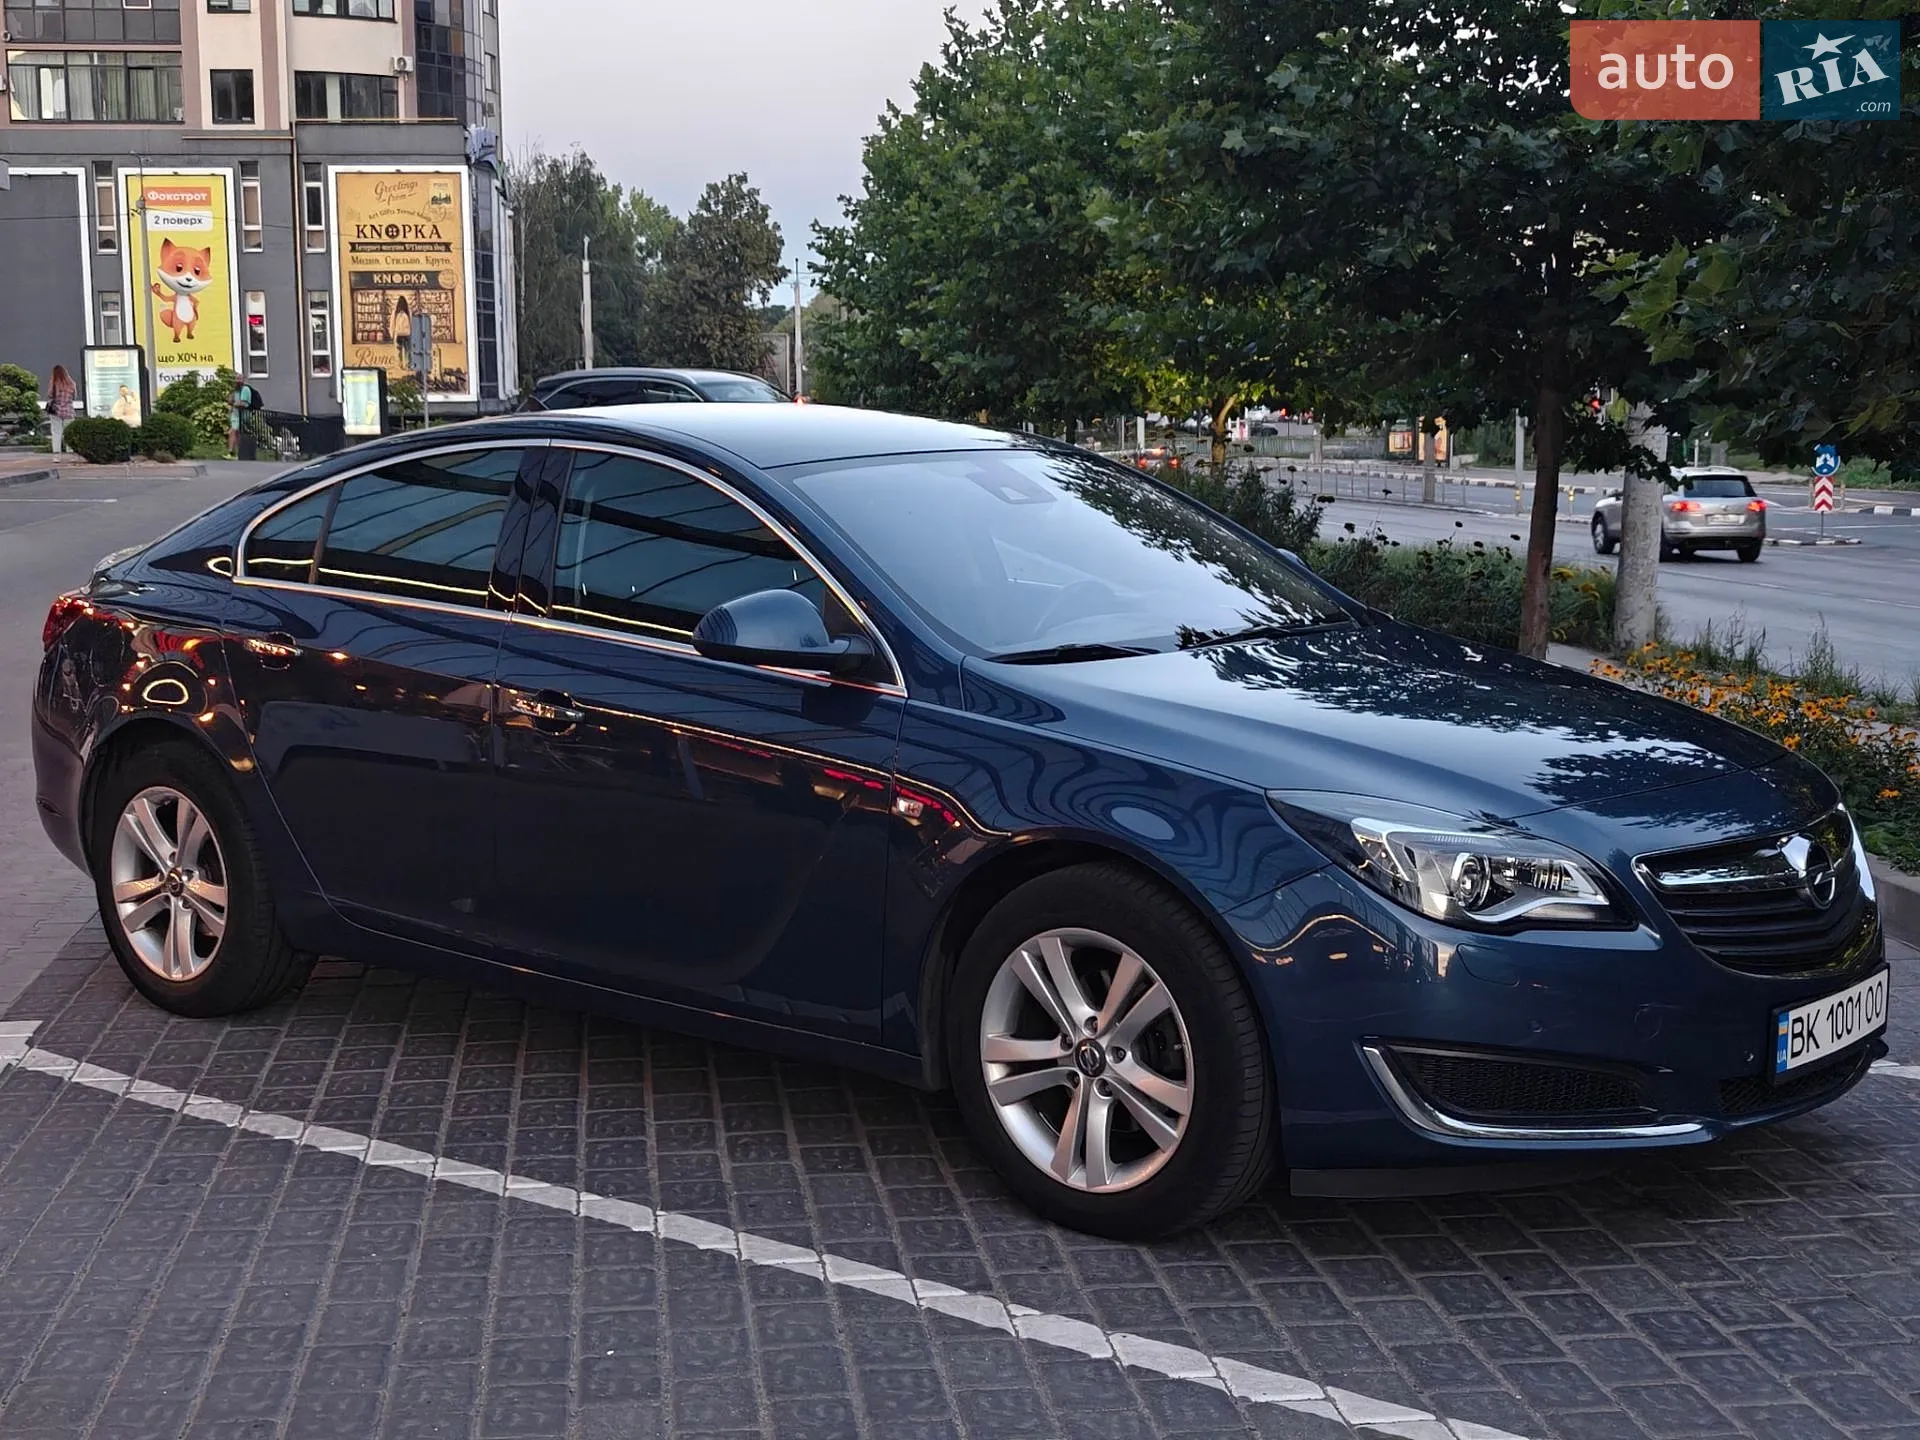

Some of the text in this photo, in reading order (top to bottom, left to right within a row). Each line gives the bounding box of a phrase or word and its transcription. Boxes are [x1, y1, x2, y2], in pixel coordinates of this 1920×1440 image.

[147, 190, 208, 202] Фокстрот
[153, 215, 203, 227] 2 поверх
[355, 224, 443, 240] KNOPKA
[373, 273, 429, 284] KNOPKA
[157, 352, 214, 363] що ХОЧ на
[1790, 1009, 1821, 1059] BK
[1826, 991, 1862, 1044] 1001
[1777, 1050, 1787, 1064] UA
